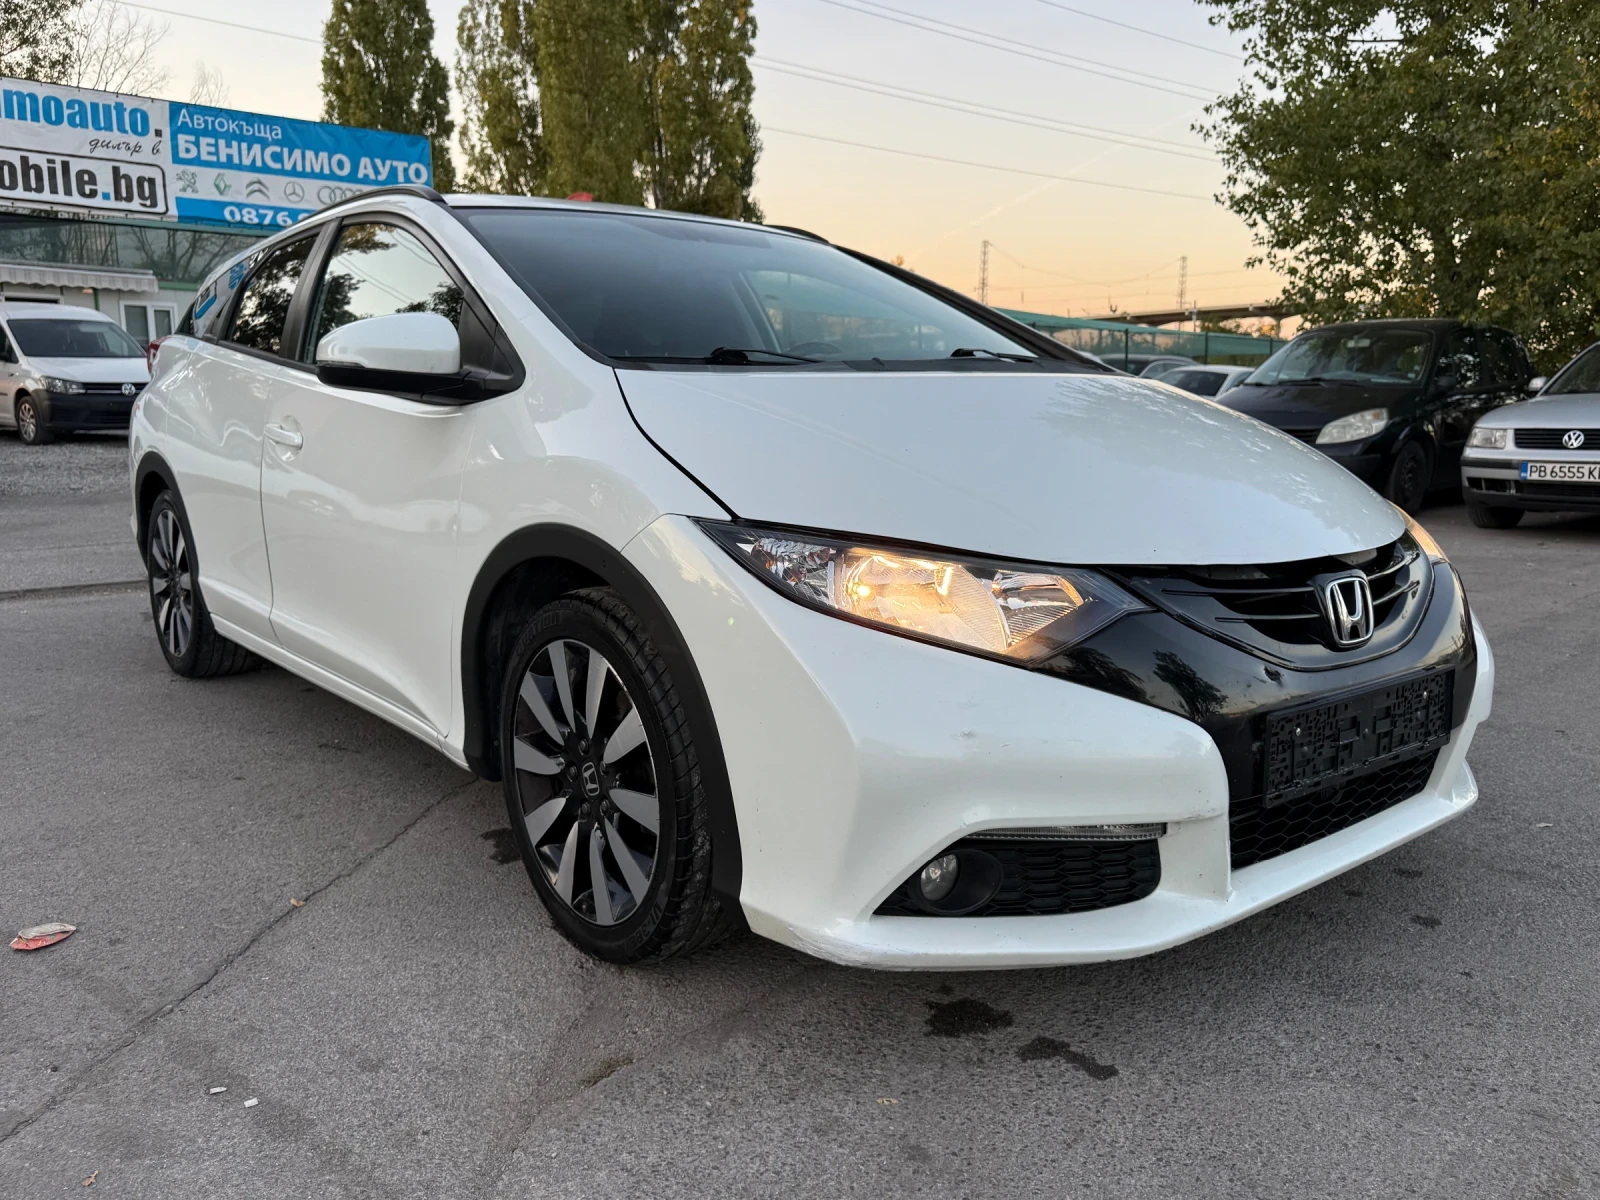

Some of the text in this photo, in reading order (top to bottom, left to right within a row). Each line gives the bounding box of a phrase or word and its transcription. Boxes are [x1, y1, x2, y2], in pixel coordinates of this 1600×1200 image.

[0, 89, 163, 137] moauto.
[177, 108, 282, 142] Автокъща
[177, 133, 429, 184] БЕНИСИМО АУТО
[223, 206, 293, 227] 0876
[1550, 466, 1585, 479] 6555
